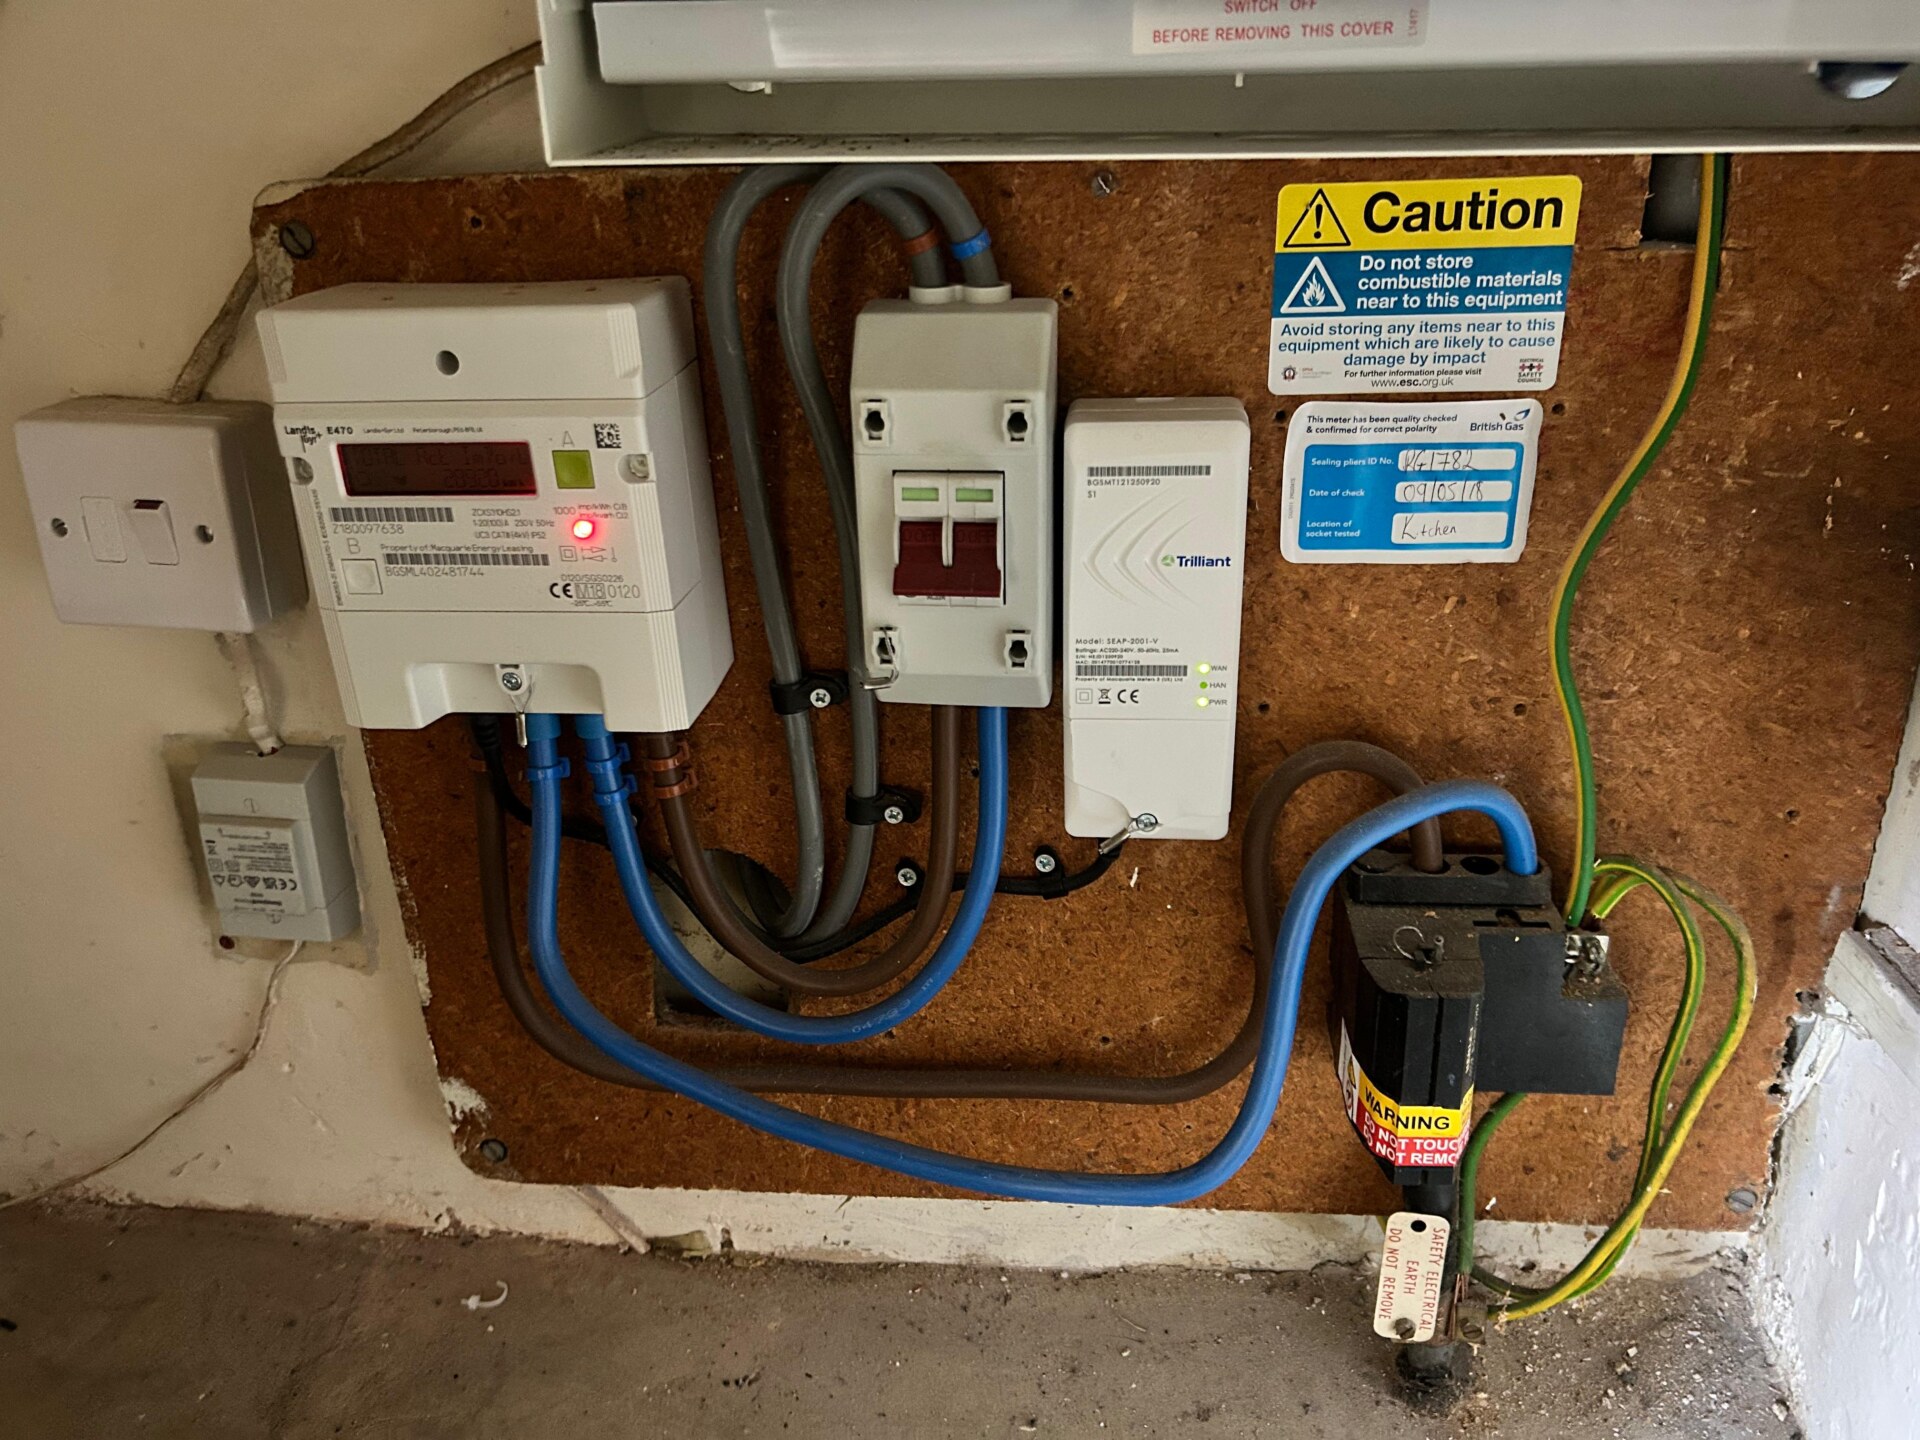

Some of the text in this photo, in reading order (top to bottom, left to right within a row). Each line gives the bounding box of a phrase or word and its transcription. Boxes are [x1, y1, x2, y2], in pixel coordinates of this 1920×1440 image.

[1225, 0, 1317, 13] SWITCH OFF
[1152, 21, 1394, 43] BEFORE REMOVING THIS COVER
[1363, 188, 1563, 233] Caution
[1360, 255, 1473, 271] Do not store
[1358, 270, 1562, 290] combustible materials
[1357, 291, 1563, 310] near to this equipment
[1281, 318, 1556, 340] Avoid storing any items near to this
[1279, 335, 1556, 354] equipment which are likely to cause
[1343, 351, 1486, 369] damage by impact
[1358, 370, 1387, 378] further
[1388, 369, 1435, 378] information
[1436, 368, 1463, 378] please
[1463, 368, 1482, 377] visit
[1371, 377, 1454, 389] www.esc.org.uk
[1307, 414, 1458, 425] This meter has been quality checked
[1470, 421, 1524, 432] British Gas
[284, 425, 316, 435] Landis
[327, 426, 354, 435] E470
[1306, 424, 1438, 435] & confirmed for correct polarity
[561, 431, 575, 447] A
[1311, 457, 1394, 467] Sealing pliers ID No.
[1087, 490, 1097, 499] S1
[1309, 488, 1365, 497] Date of check
[1403, 479, 1484, 502] 09/05/18
[552, 506, 577, 516] 1000
[1307, 520, 1352, 529] Location of
[1306, 529, 1361, 538] socket tested
[346, 538, 362, 555] B
[380, 543, 416, 553] Property
[429, 544, 471, 554] Macquarie
[471, 545, 500, 554] Energy
[501, 544, 534, 554] Leasing
[1176, 555, 1232, 567] Trilliant
[608, 584, 641, 600] 0120
[1365, 1087, 1450, 1130] WARNING
[1364, 1111, 1463, 1151] DO NOT TOUC
[1363, 1125, 1459, 1165] DO NOT REMO
[1378, 1227, 1403, 1319] DO NOT REMOVE
[1403, 1260, 1420, 1295] EARTH
[1419, 1227, 1447, 1331] SAFETY ELECTRICAL
